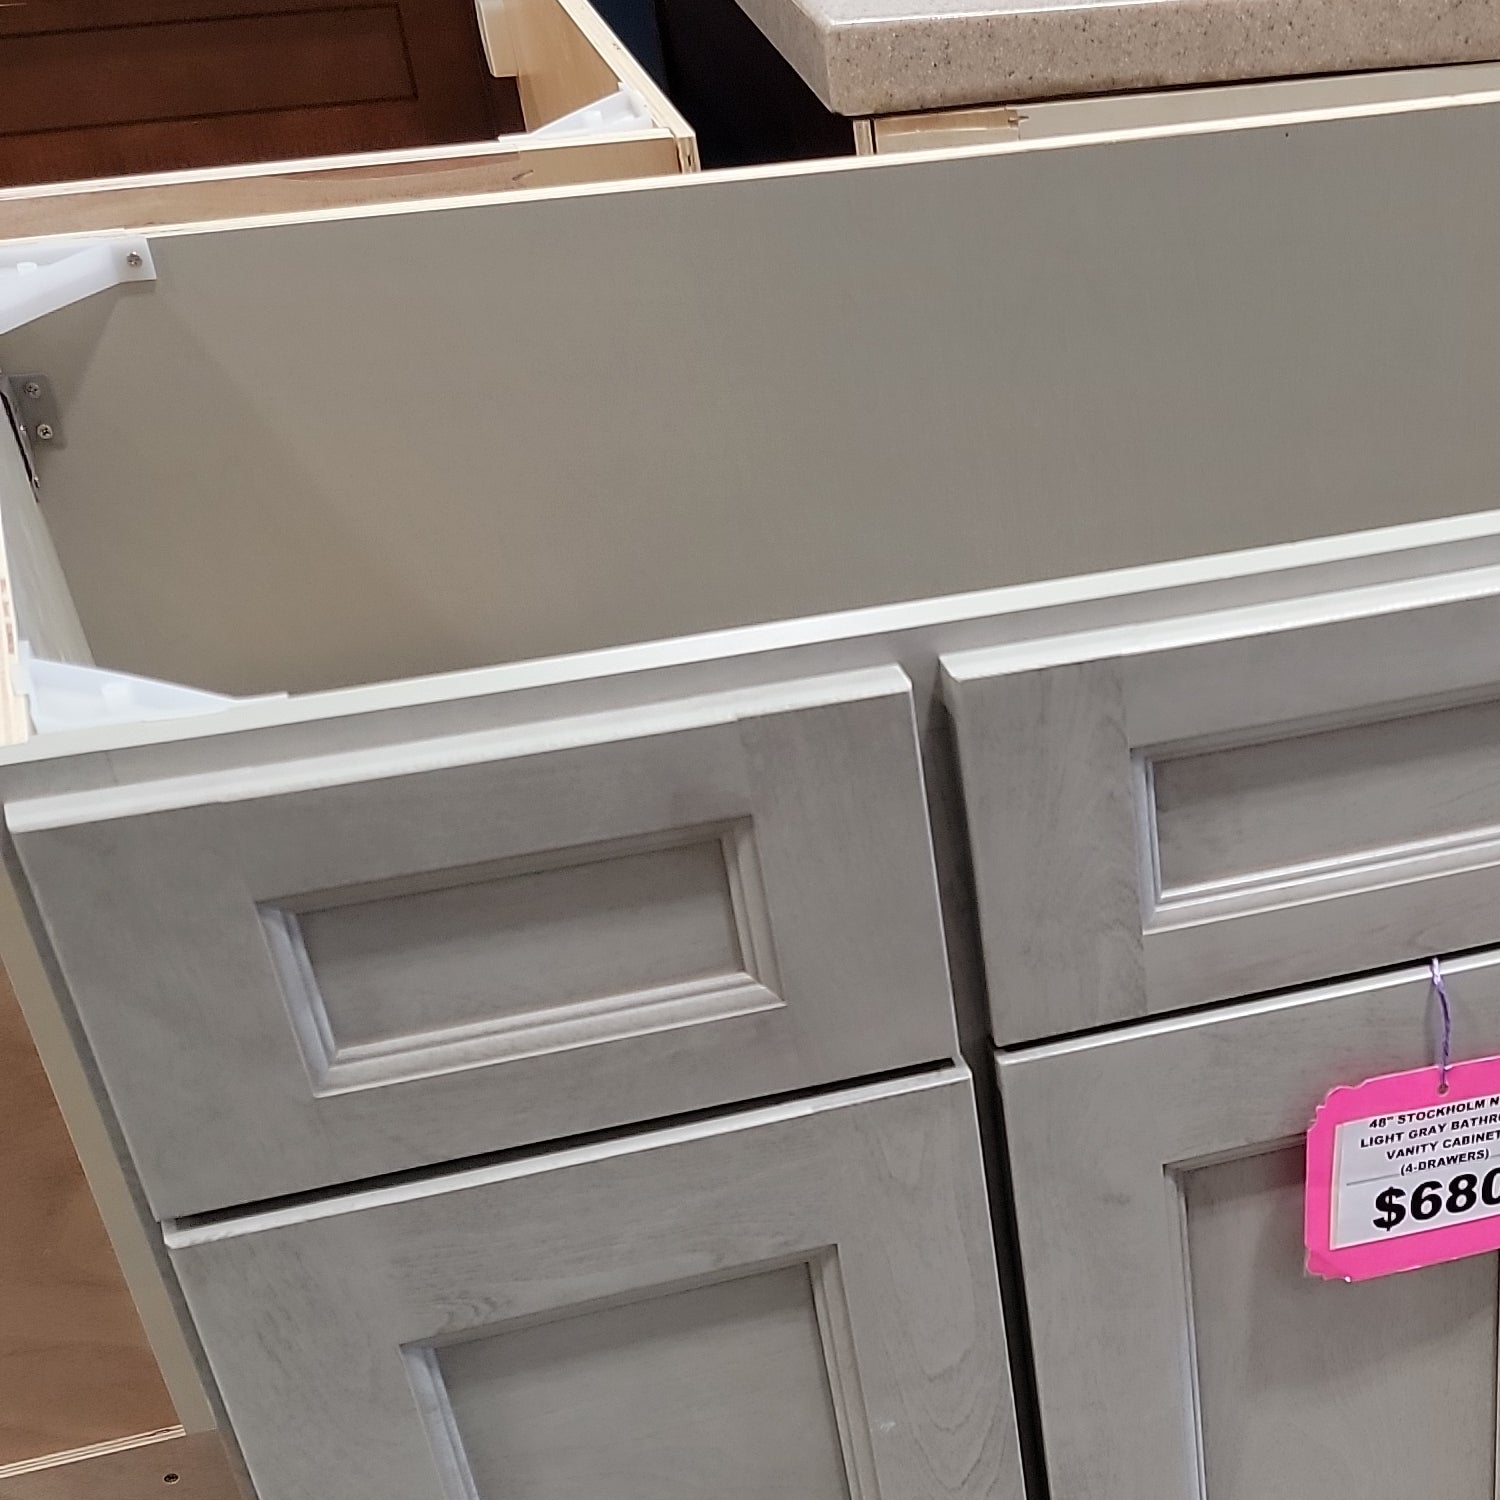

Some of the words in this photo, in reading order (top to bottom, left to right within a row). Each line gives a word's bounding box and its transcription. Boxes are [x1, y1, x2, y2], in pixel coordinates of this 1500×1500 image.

[1369, 1116, 1394, 1129] 48"
[1398, 1099, 1485, 1125] STOCKHOLM
[1361, 1132, 1405, 1148] LIGHT
[1409, 1124, 1447, 1140] GRAY
[1387, 1141, 1439, 1160] VANITY
[1400, 1149, 1489, 1176] (4-DRAWERS)
